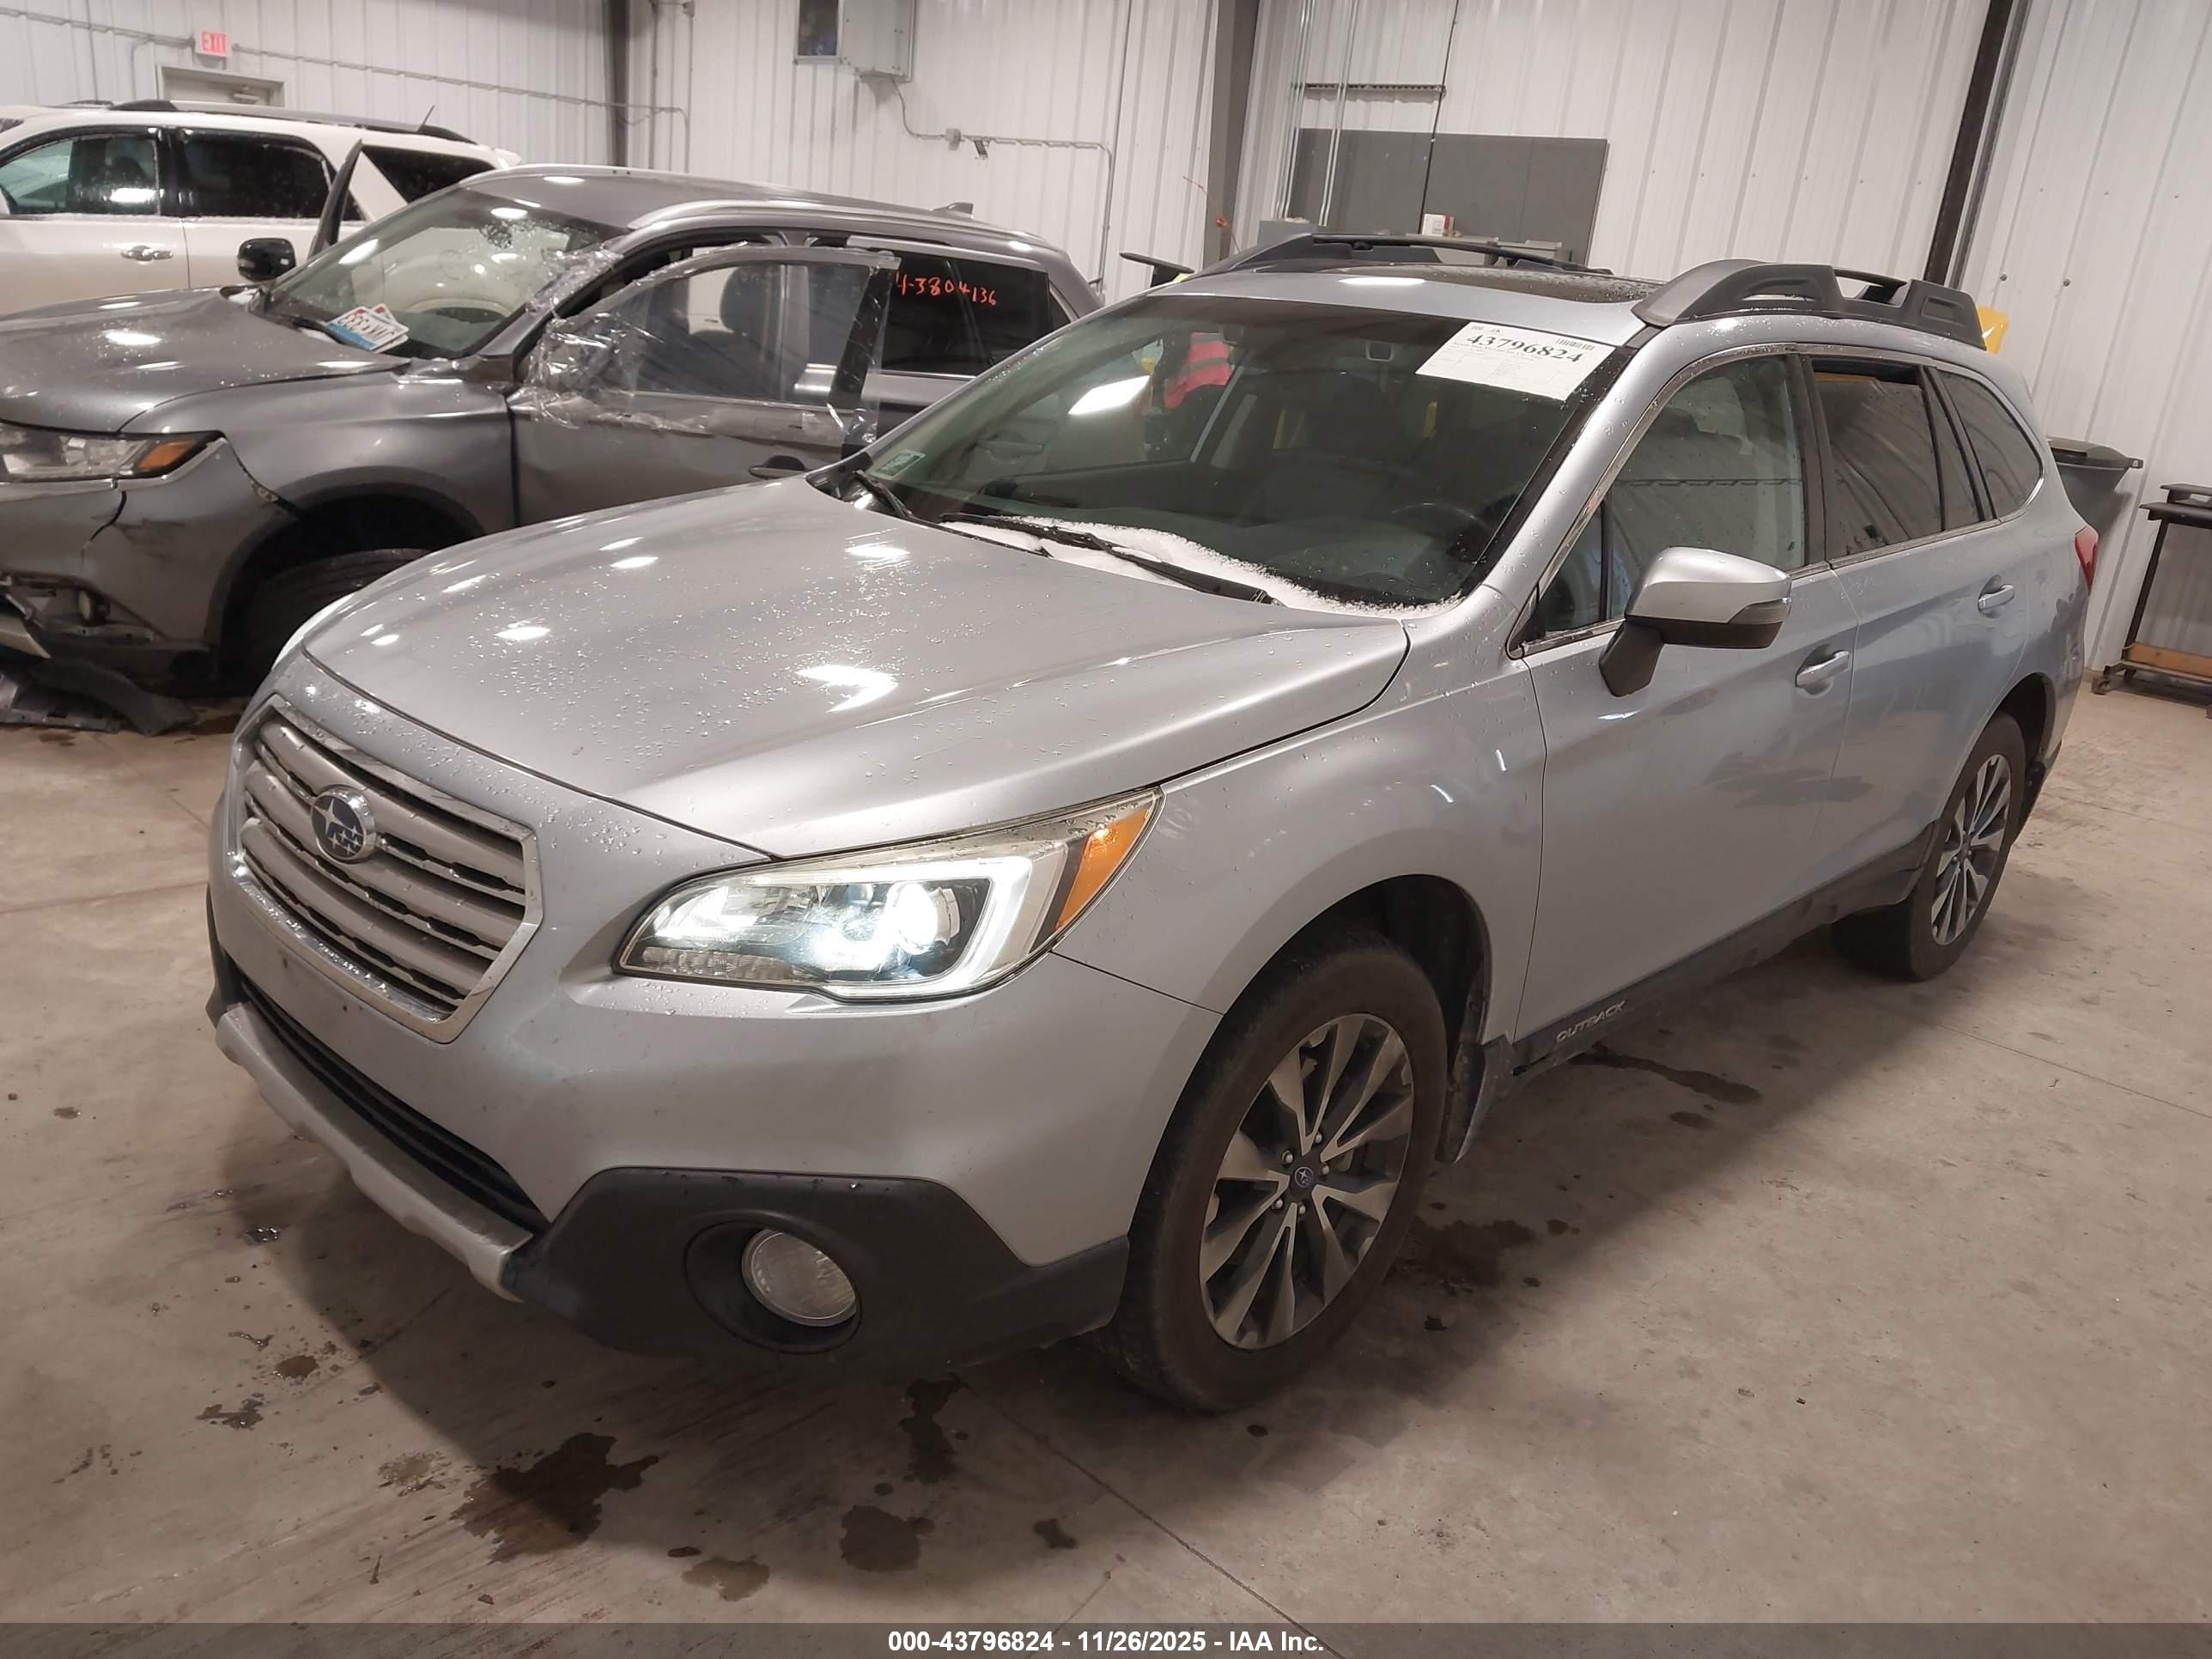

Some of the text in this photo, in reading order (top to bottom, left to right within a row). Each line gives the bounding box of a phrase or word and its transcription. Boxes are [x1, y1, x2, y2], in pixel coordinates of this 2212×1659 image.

[201, 32, 226, 54] EXIT
[1467, 334, 1583, 362] 43796824
[1556, 1000, 1626, 1043] OUTBACK
